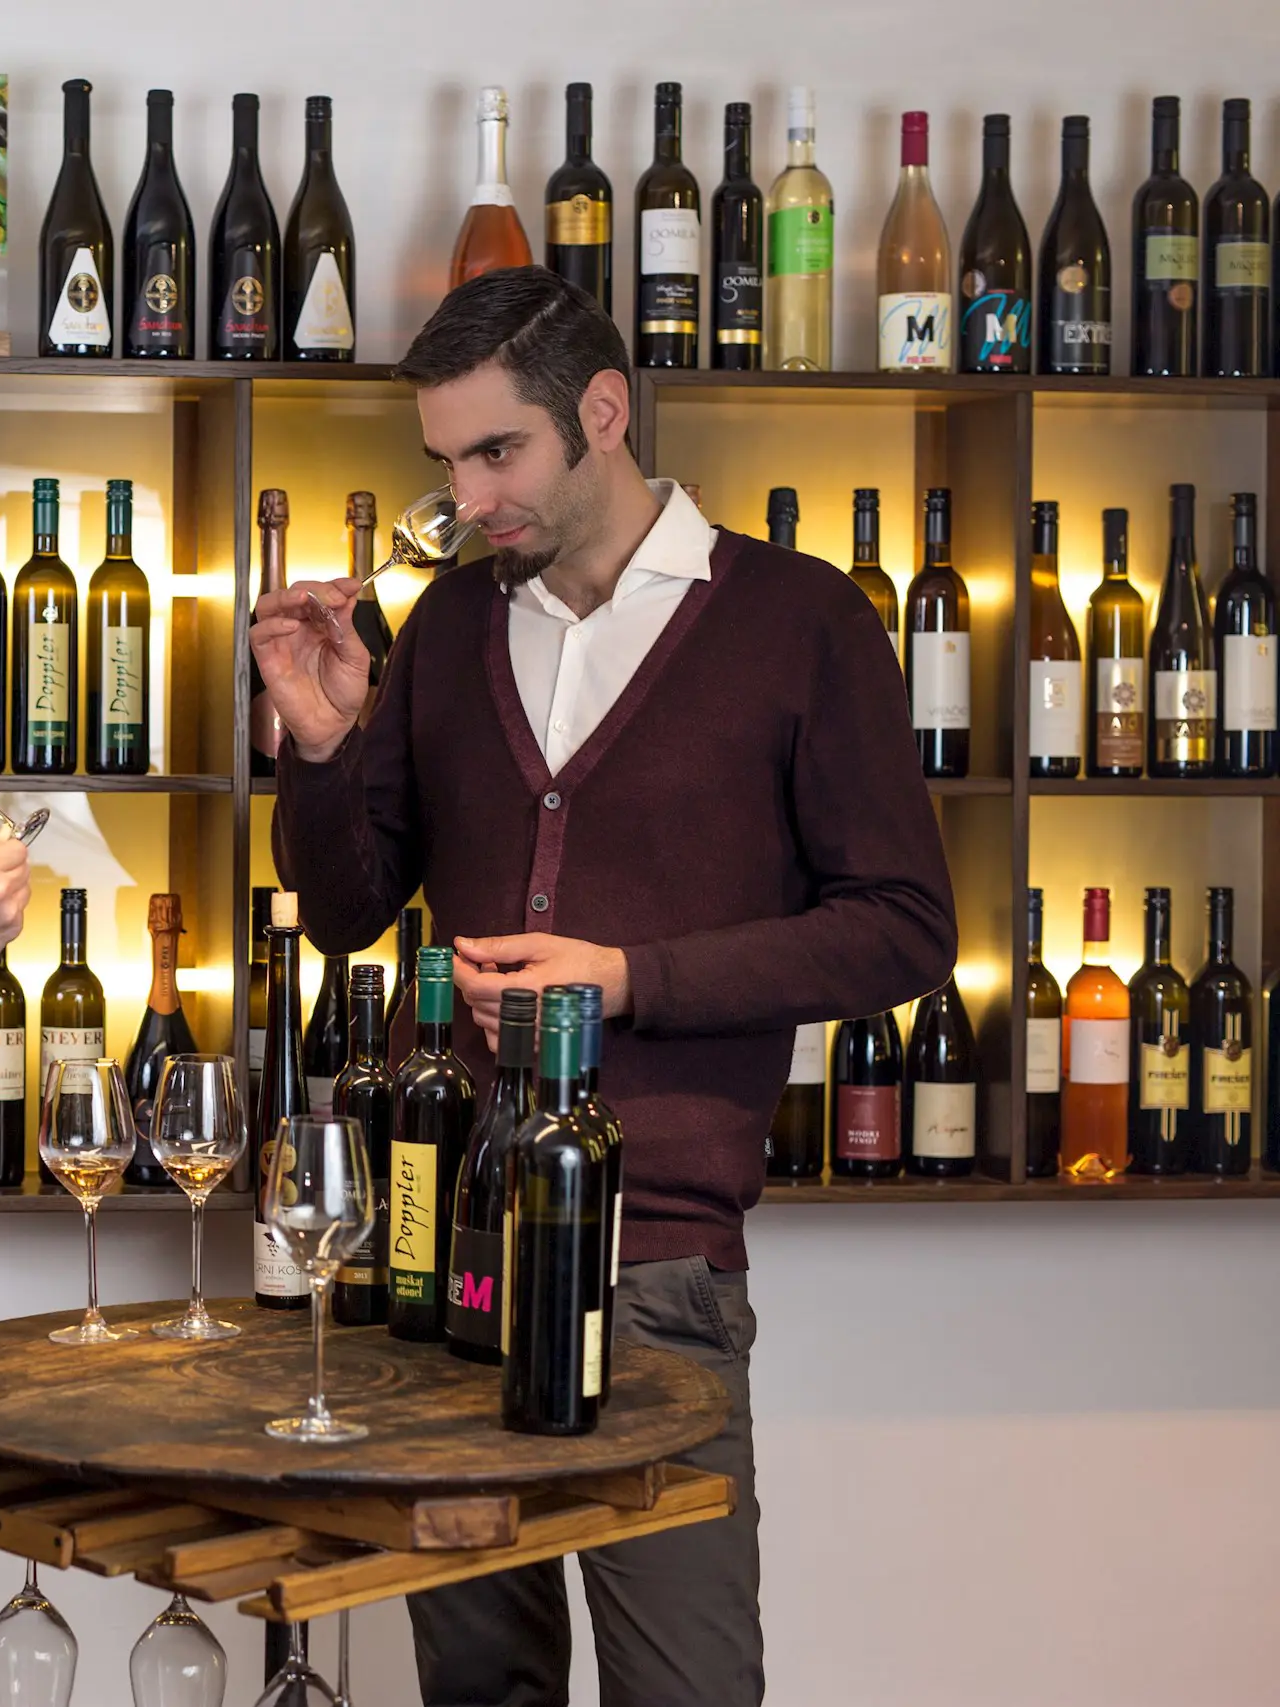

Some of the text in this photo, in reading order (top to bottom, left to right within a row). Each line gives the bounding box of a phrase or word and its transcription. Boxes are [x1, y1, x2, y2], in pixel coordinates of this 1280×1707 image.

[906, 315, 935, 342] M
[35, 633, 65, 713] Doppler
[109, 636, 140, 716] Doppler
[42, 1031, 102, 1045] STEYER
[394, 1154, 430, 1261] Doppler
[278, 1264, 302, 1276] KOS
[395, 1274, 424, 1286] muškat
[396, 1285, 423, 1298] ottonel
